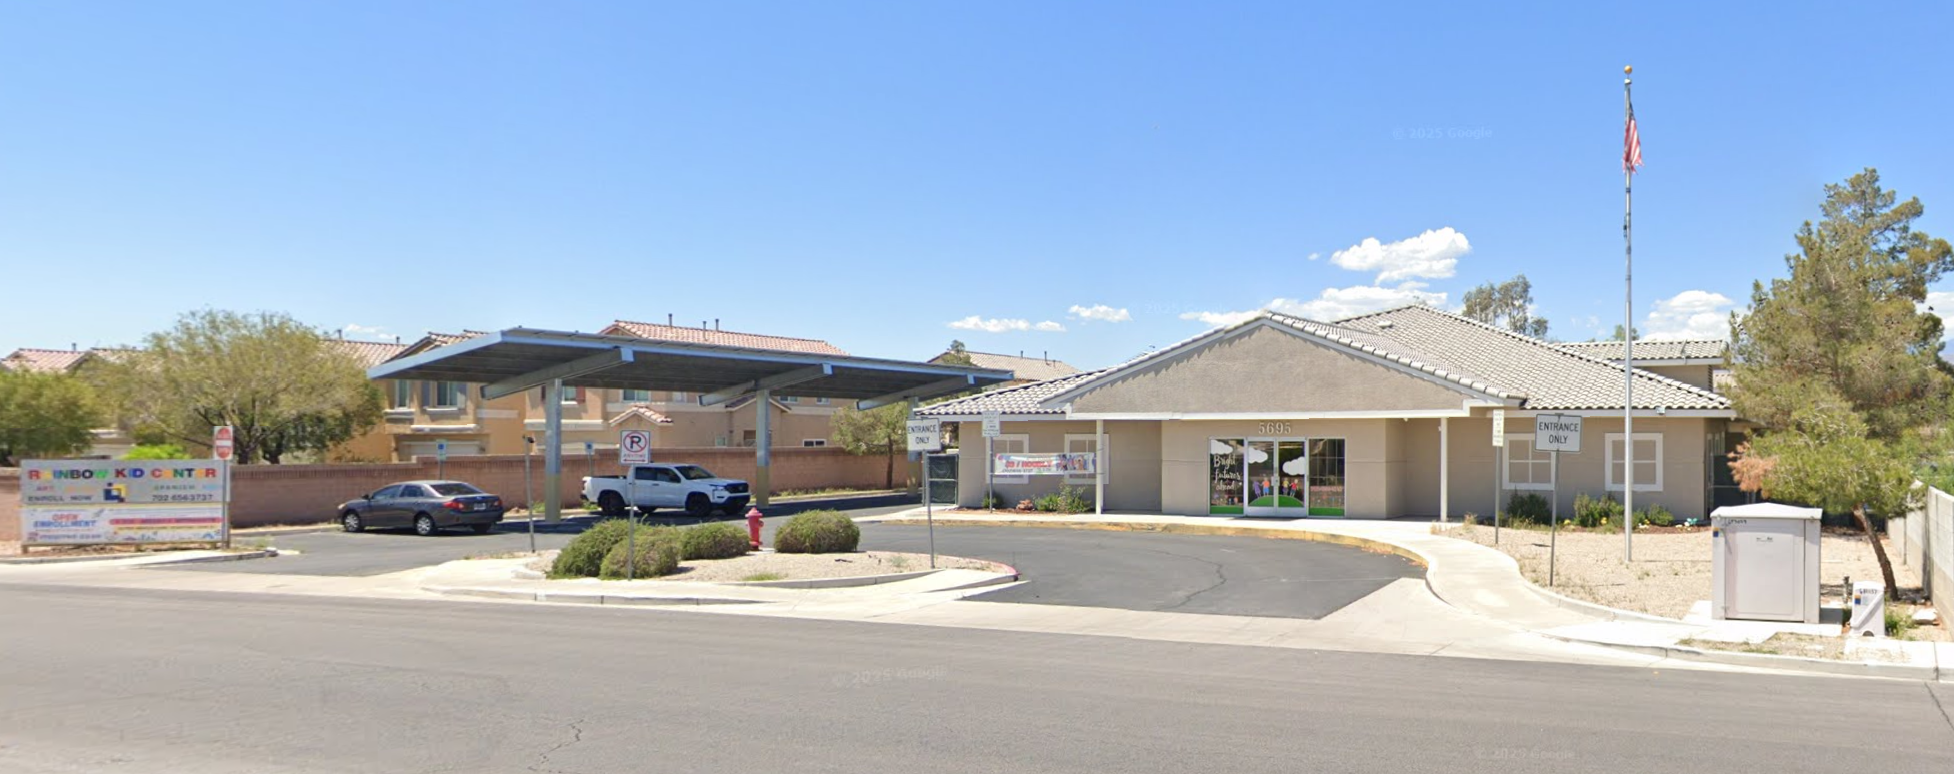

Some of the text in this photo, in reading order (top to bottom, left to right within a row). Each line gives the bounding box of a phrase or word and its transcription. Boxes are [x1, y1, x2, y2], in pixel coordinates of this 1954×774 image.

[908, 424, 937, 434] ENTRANCE
[1258, 422, 1292, 435] 5695
[1539, 422, 1579, 432] ENTRANCE
[915, 436, 930, 444] ONLY
[1548, 434, 1568, 444] ONLY
[1213, 453, 1236, 470] Bright
[28, 467, 217, 480] RAINBOW KID CENTER
[1215, 480, 1235, 491] ahead
[33, 520, 97, 528] ENROLLMENT
